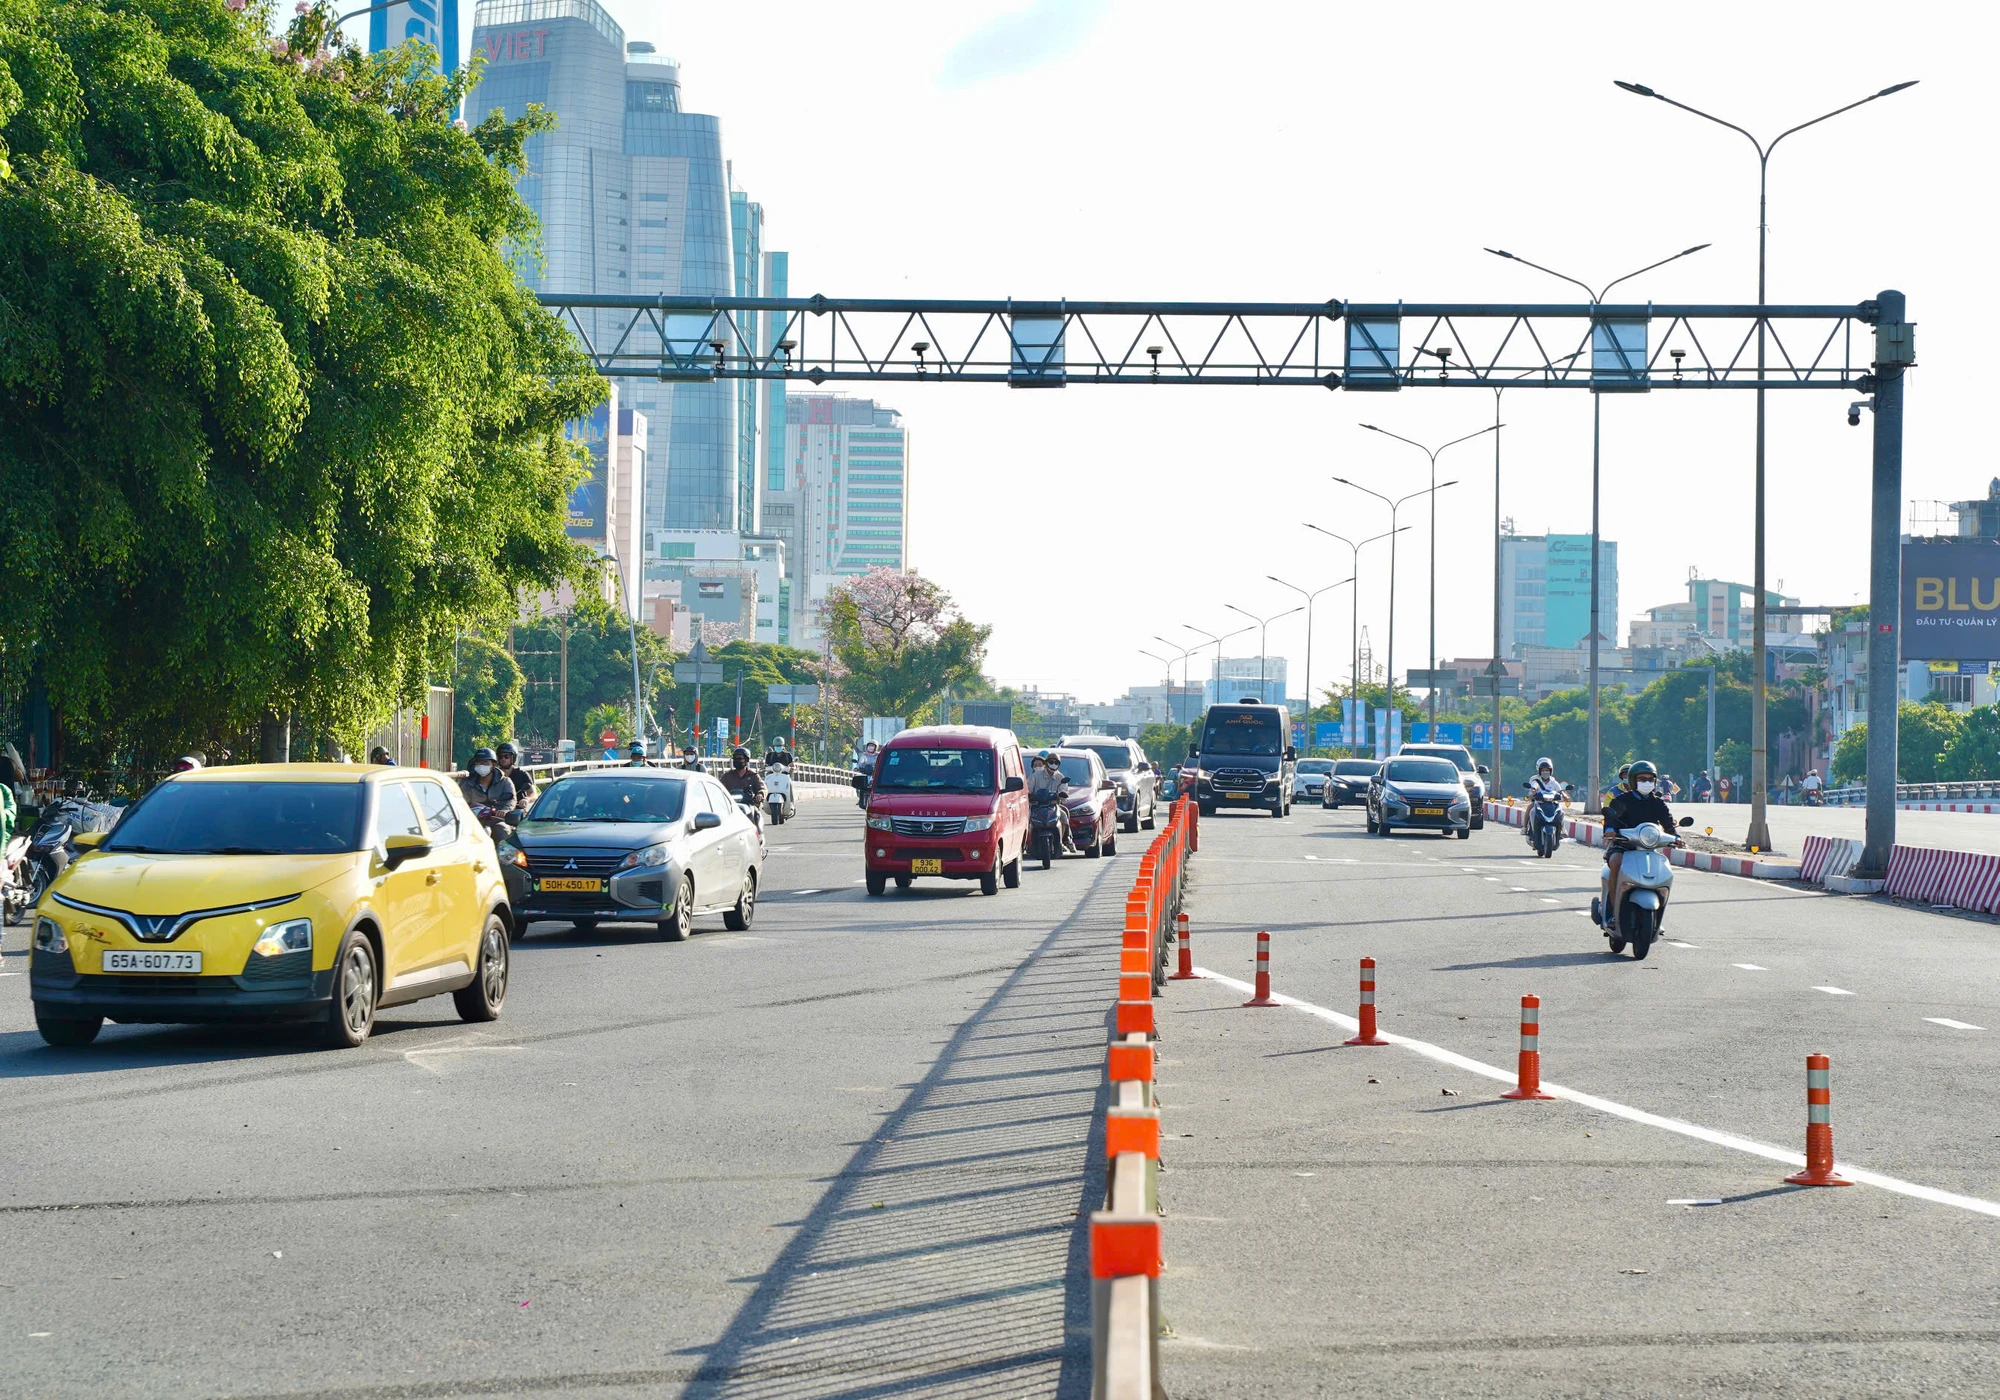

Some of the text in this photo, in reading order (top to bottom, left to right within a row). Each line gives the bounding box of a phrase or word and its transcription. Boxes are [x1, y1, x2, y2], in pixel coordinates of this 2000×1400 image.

[486, 29, 549, 61] VIET
[1986, 617, 1997, 626] LÝ
[545, 880, 596, 889] 50H-450.17
[111, 954, 193, 969] 65A-607.73
